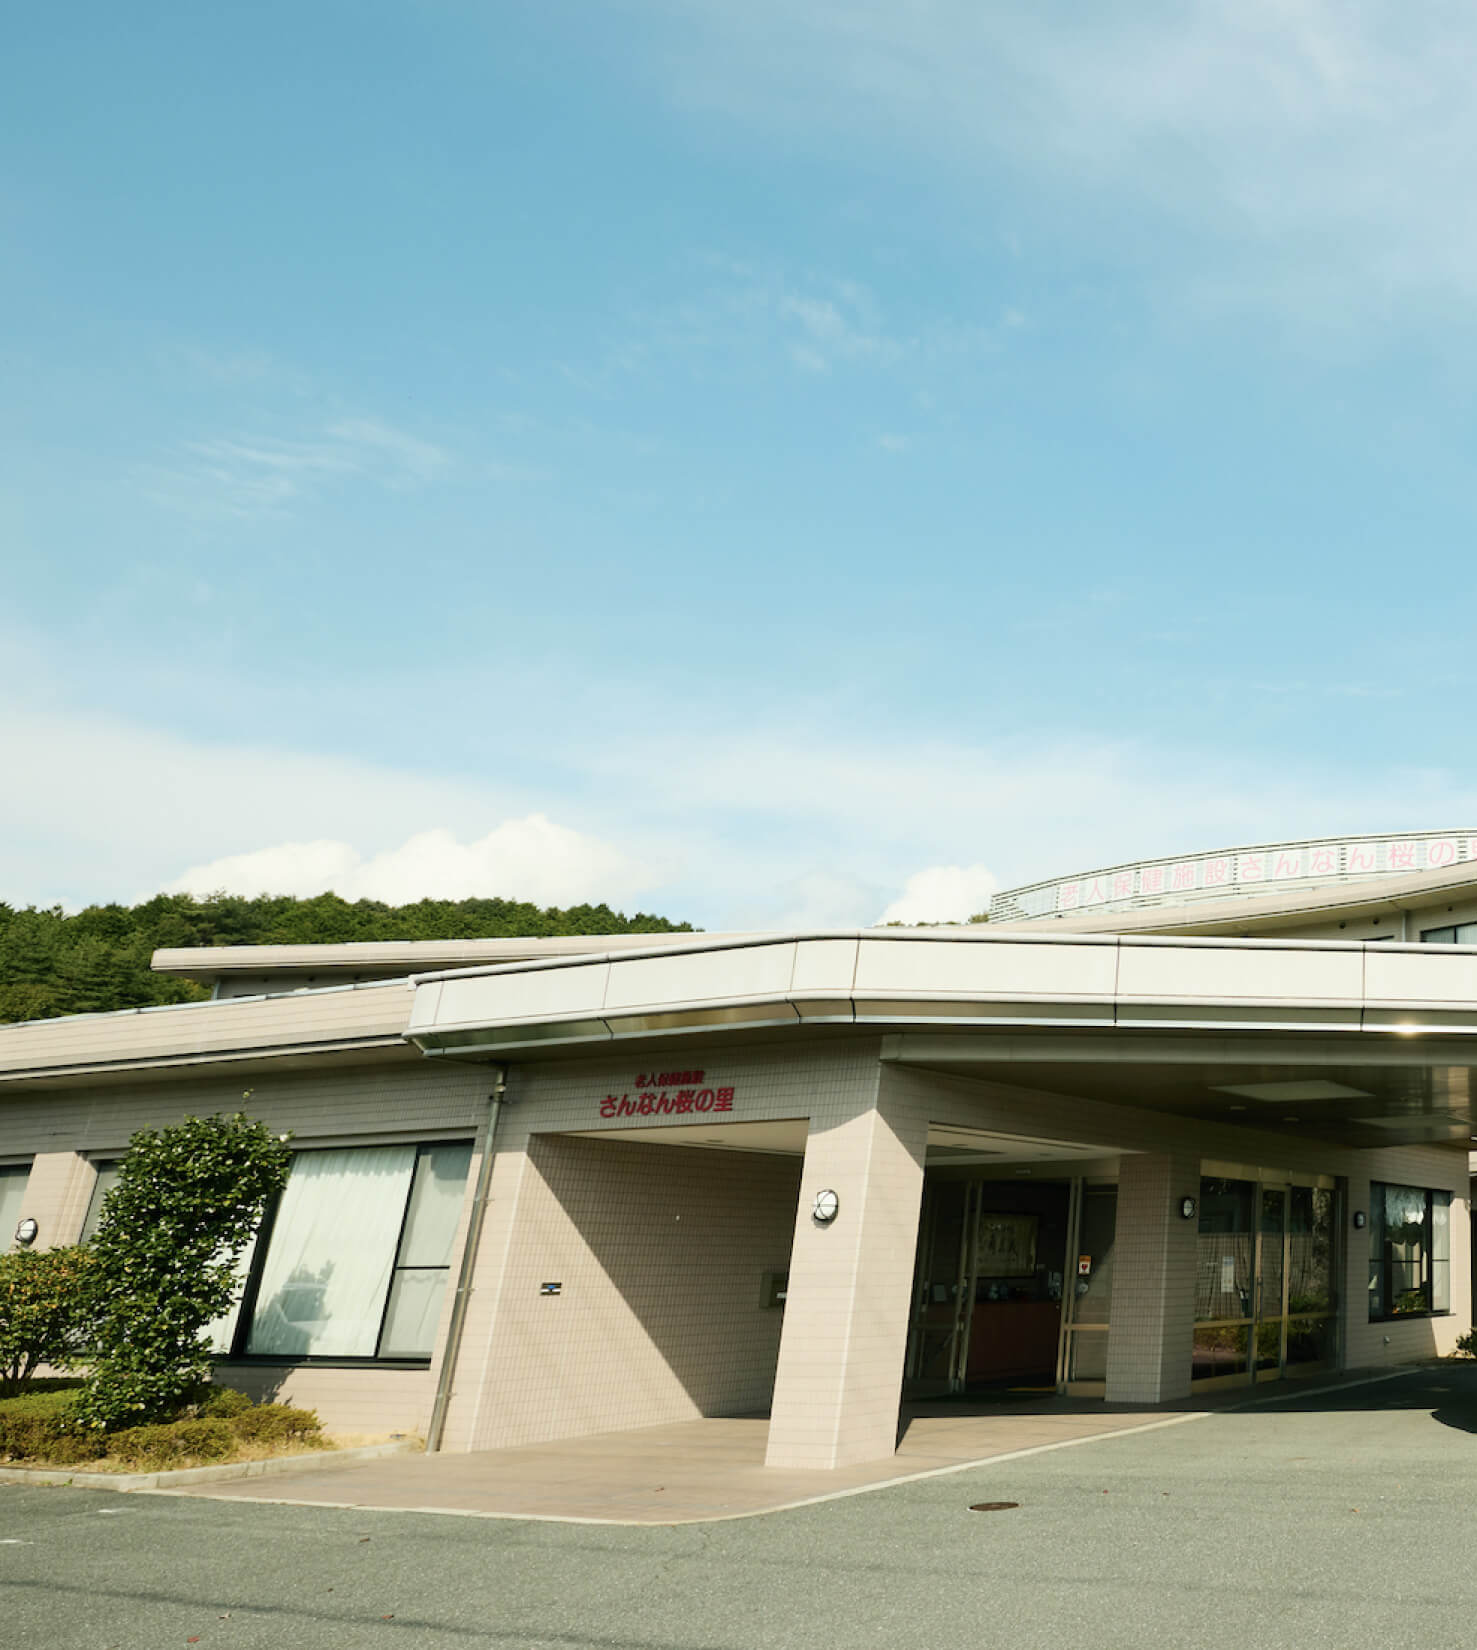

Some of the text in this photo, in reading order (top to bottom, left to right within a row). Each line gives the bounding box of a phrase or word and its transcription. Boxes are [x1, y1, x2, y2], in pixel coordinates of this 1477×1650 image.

[599, 1087, 735, 1118] さんなん桜の里
